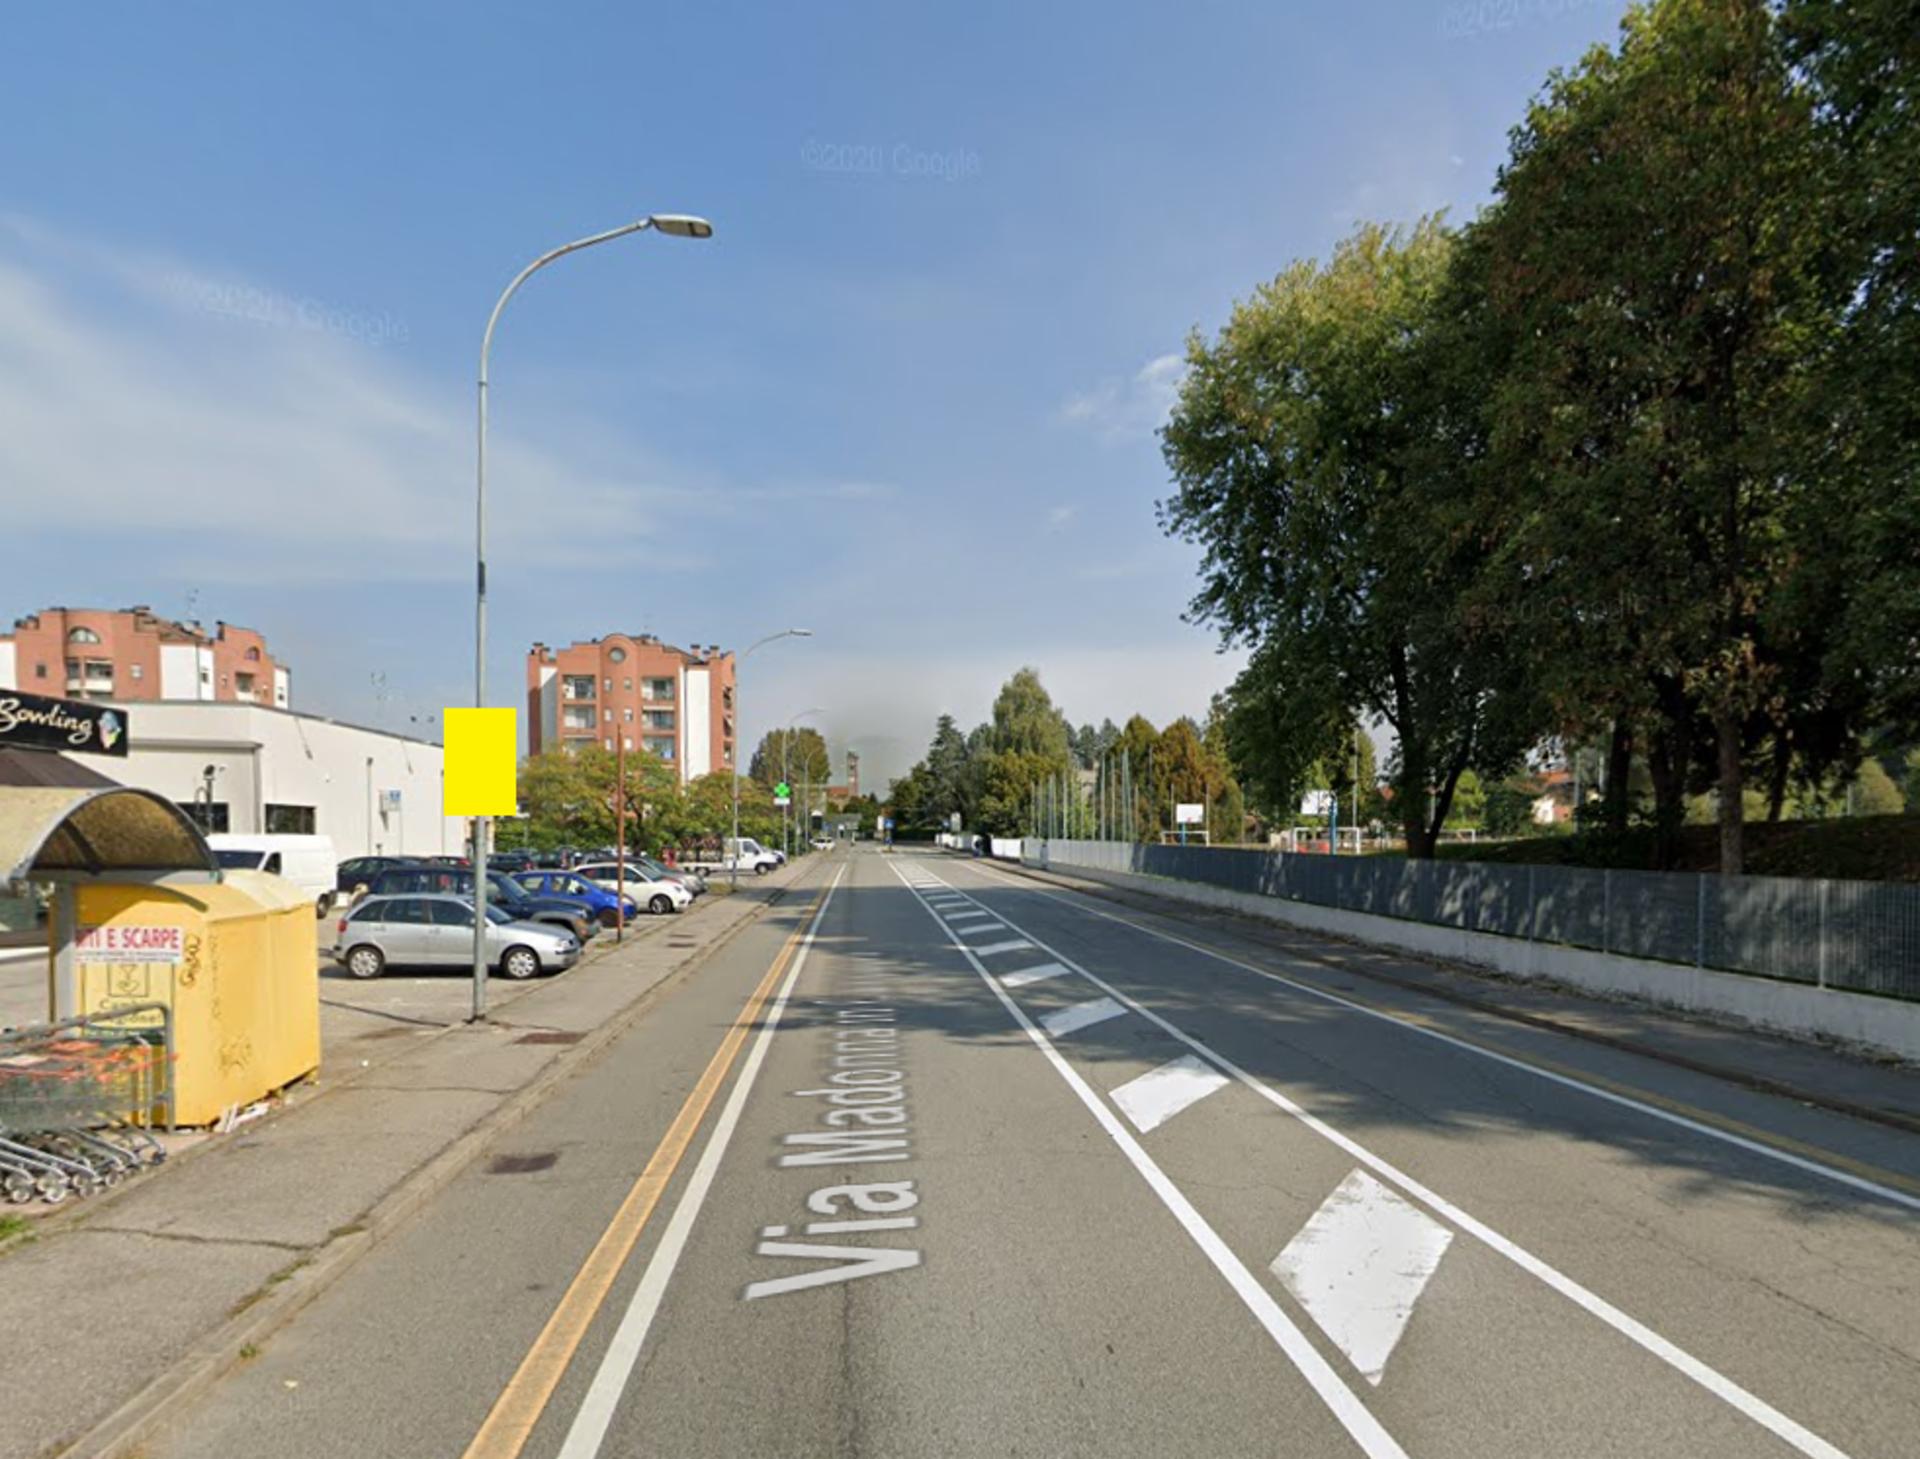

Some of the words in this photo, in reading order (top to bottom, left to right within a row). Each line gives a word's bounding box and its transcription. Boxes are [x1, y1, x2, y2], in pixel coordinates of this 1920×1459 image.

[107, 928, 116, 948] E
[122, 928, 179, 948] SCARPE
[745, 1181, 926, 1300] Via
